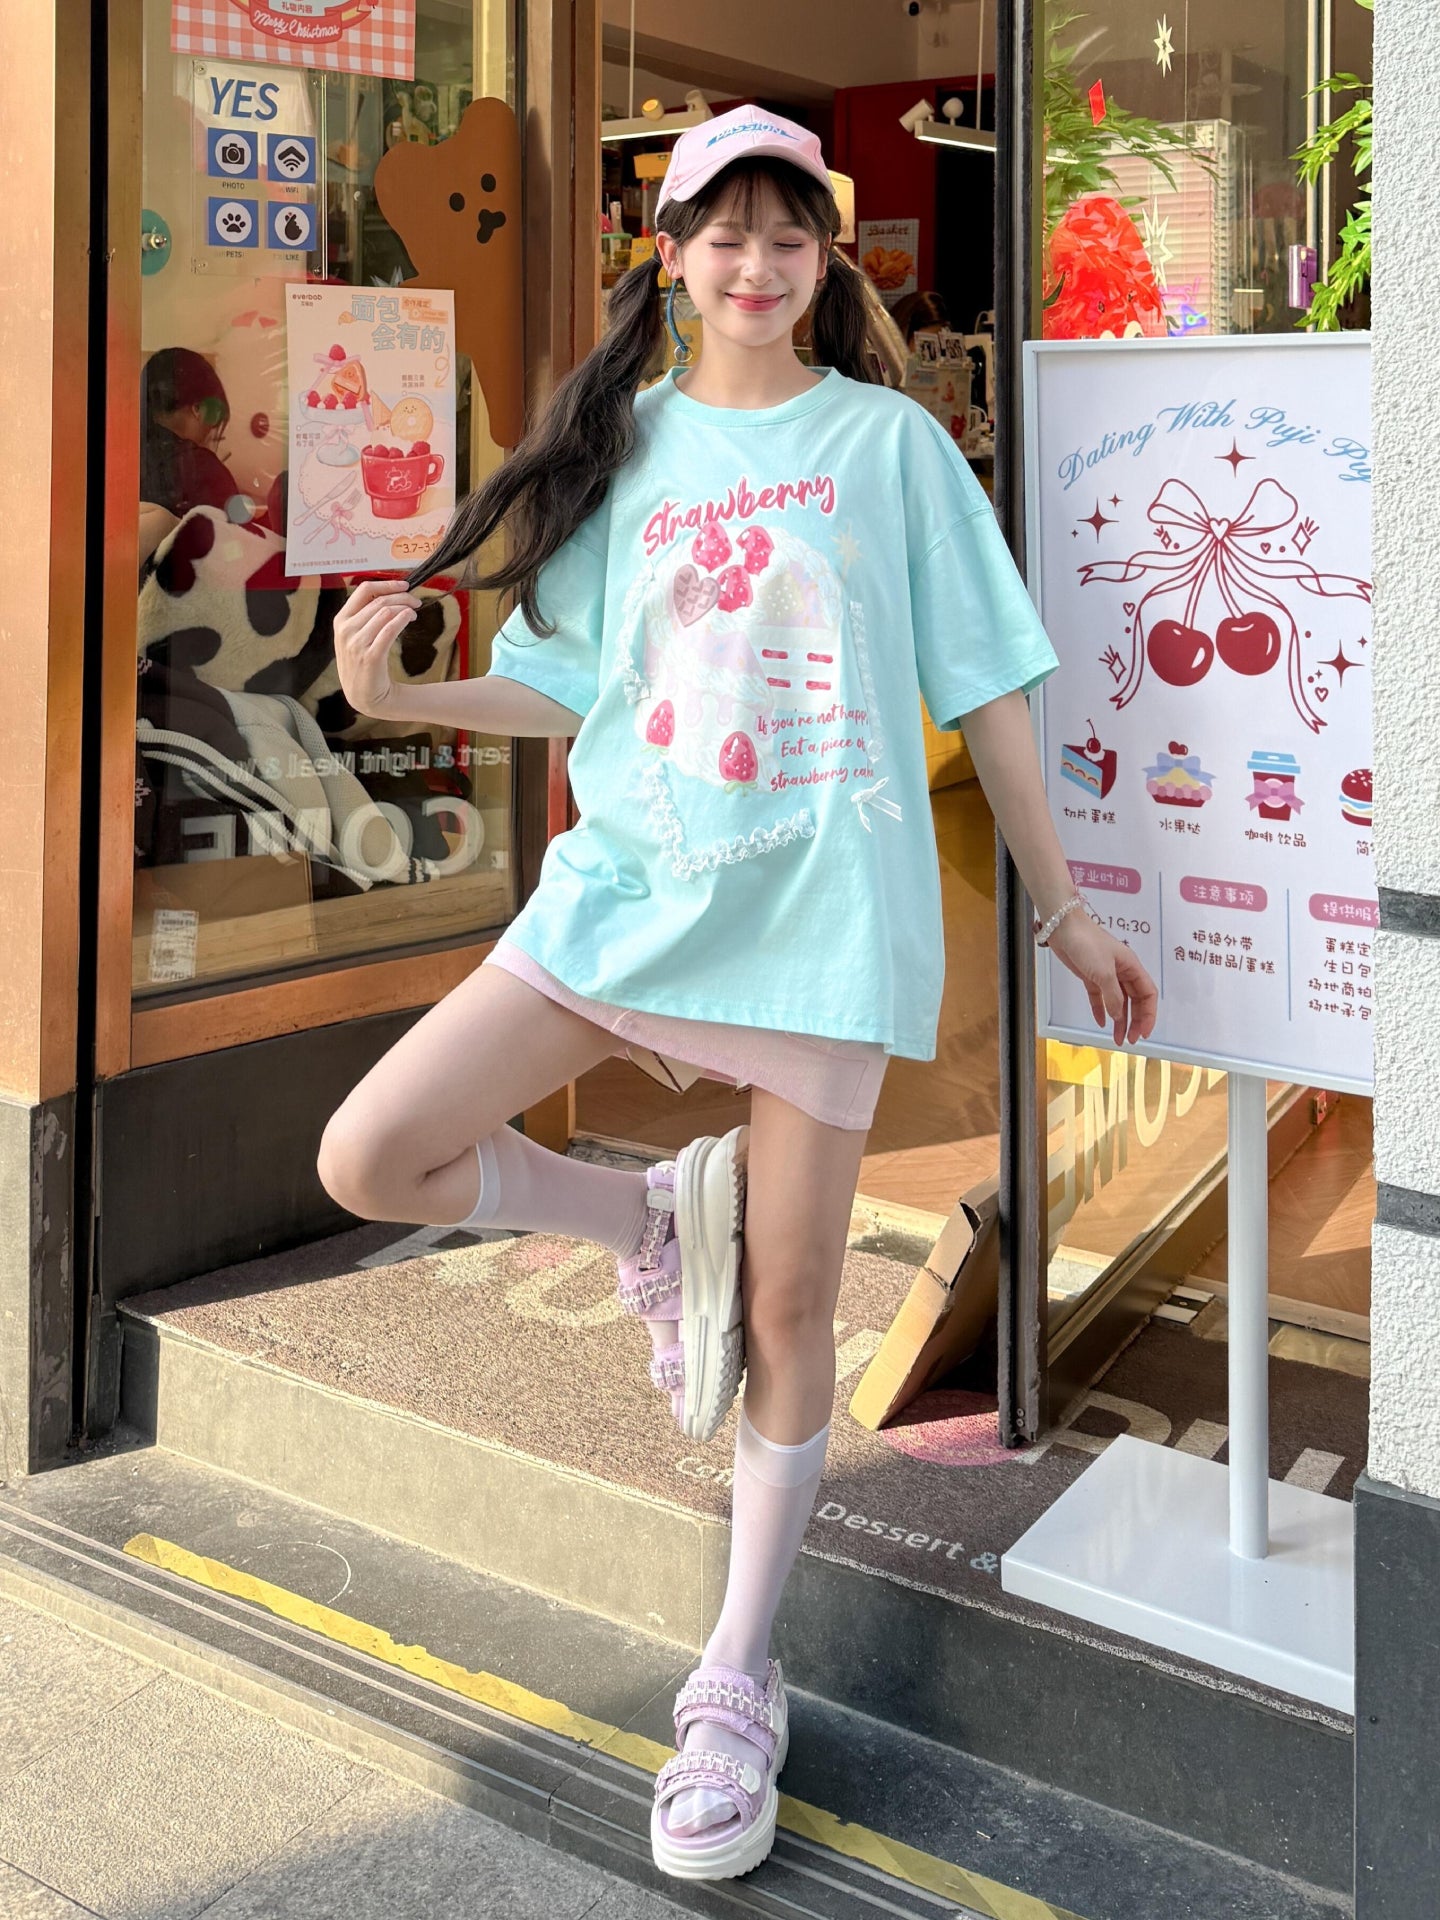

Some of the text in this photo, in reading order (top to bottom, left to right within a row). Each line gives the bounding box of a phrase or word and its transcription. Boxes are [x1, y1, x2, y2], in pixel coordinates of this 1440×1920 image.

[253, 10, 340, 38] Merry Christmas
[210, 77, 280, 121] YES
[222, 181, 245, 190] PHOTO
[226, 250, 242, 258] PETS
[351, 294, 401, 323] 面包
[371, 322, 446, 354] 会有的
[1057, 422, 1157, 492] Dating
[1157, 398, 1238, 433] With
[1245, 406, 1322, 448] Puji
[757, 715, 768, 735] If
[816, 703, 841, 724] not
[781, 736, 808, 758] Eat
[808, 743, 817, 754] a
[820, 738, 853, 758] piece
[1064, 807, 1116, 824] 切片蛋糕
[1159, 818, 1201, 834] 水果挞
[1244, 828, 1307, 847] 咖啡饮品
[1072, 866, 1129, 888] 营业时间
[1193, 884, 1254, 905] 注意事项
[1192, 929, 1253, 950] 拒绝外带
[1174, 945, 1276, 974] 食物/甜品/蛋糕
[1308, 978, 1372, 998] 场地商拍
[1308, 998, 1372, 1021] 场地承包
[815, 1500, 966, 1561] Dessert
[969, 1551, 999, 1574] &
